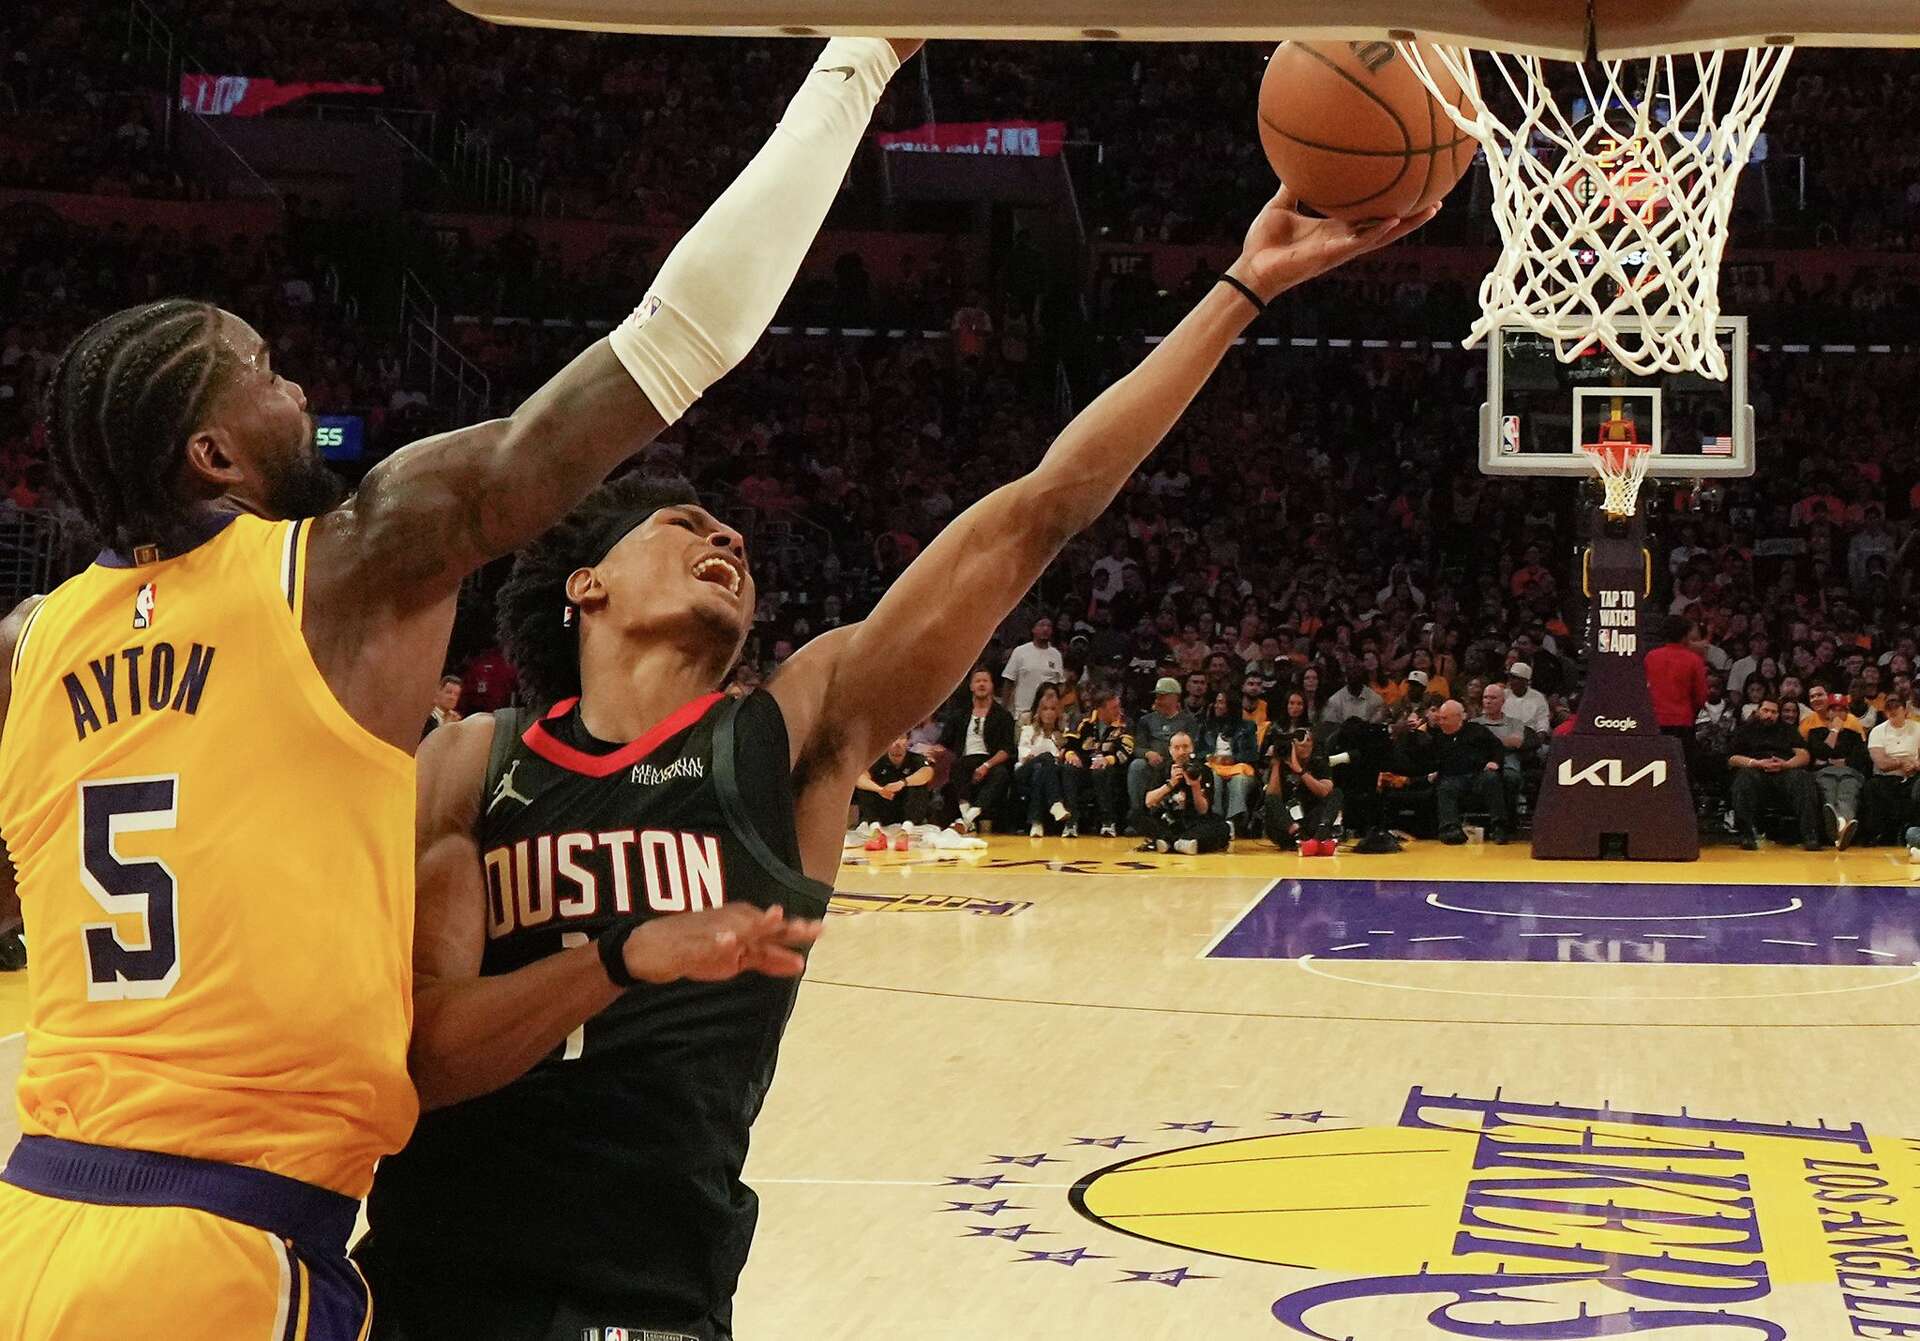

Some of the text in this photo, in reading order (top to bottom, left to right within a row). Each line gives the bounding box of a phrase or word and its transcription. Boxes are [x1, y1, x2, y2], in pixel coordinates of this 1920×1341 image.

[1599, 590, 1636, 608] TAP TO
[1599, 609, 1636, 627] WATCH
[1610, 629, 1637, 656] App
[62, 642, 215, 742] AYTON
[1594, 715, 1638, 731] Google
[1558, 758, 1667, 787] KIA
[78, 772, 181, 1002] 5
[1803, 1157, 1899, 1205] LOS
